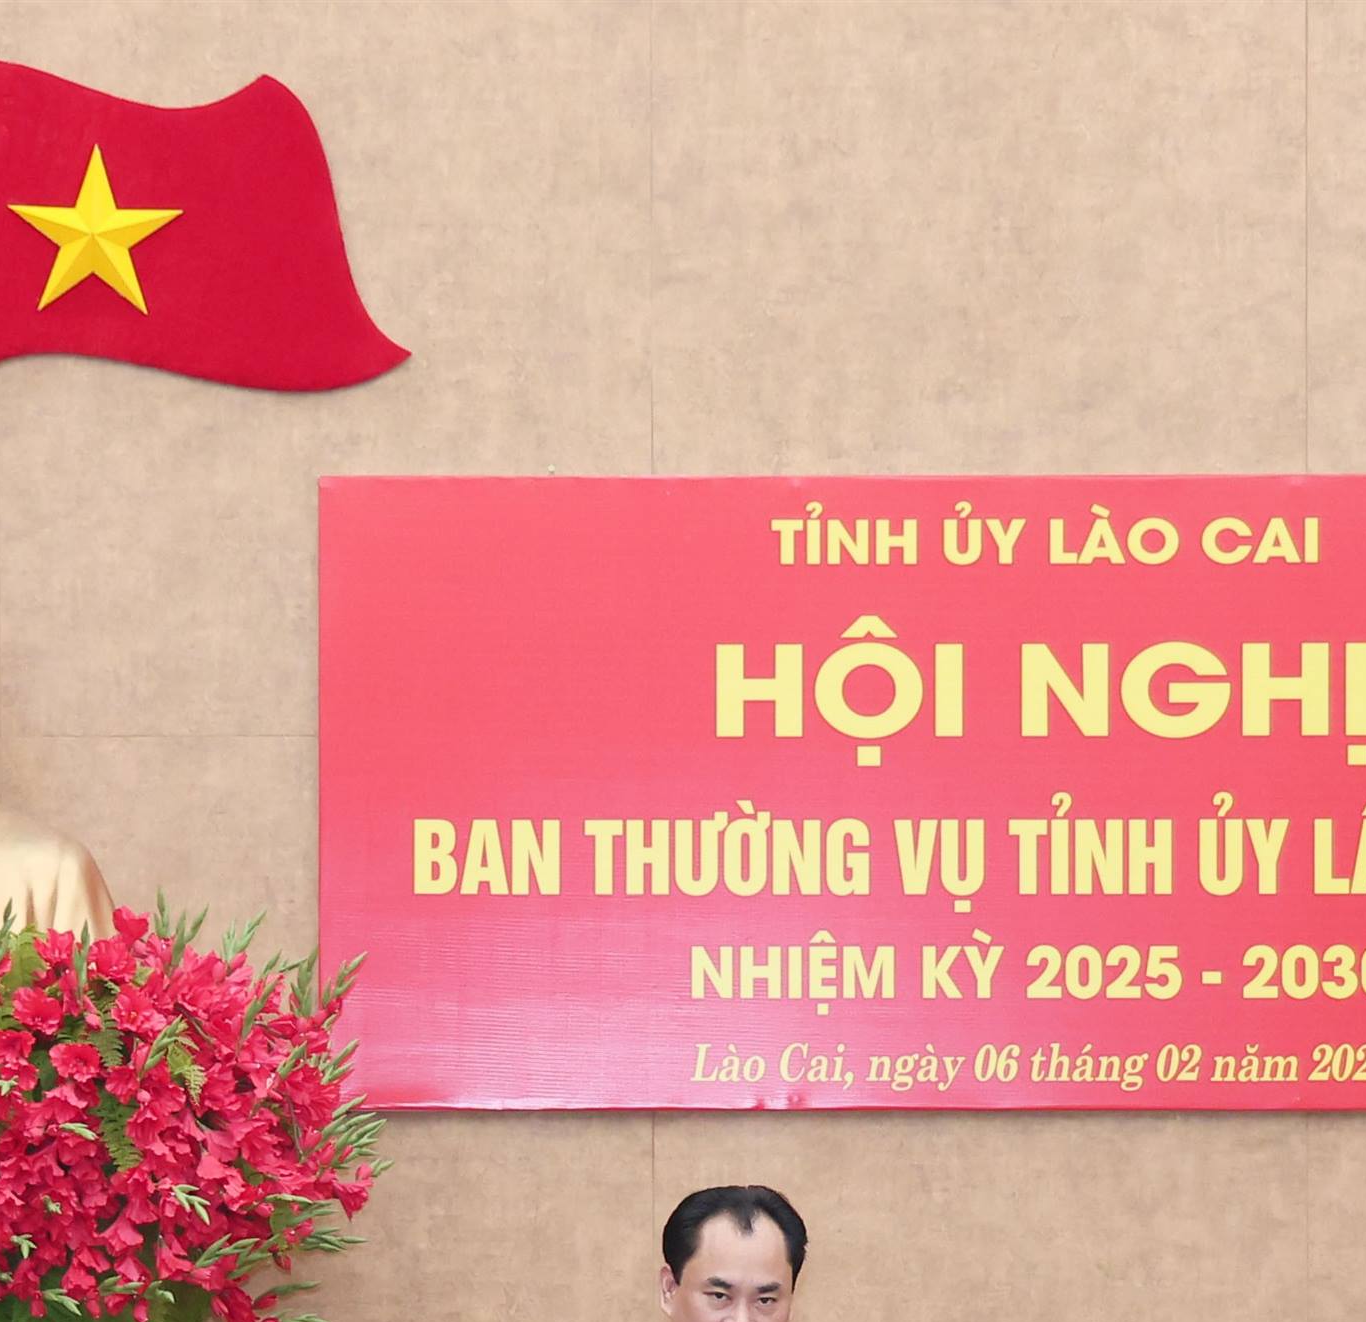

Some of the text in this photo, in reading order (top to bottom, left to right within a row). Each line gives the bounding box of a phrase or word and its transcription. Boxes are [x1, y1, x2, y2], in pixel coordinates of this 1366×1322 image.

[769, 499, 1320, 567] TỈNH ỦY LÀO CAI
[714, 614, 965, 768] HỘI
[412, 817, 562, 897] BAN
[583, 798, 872, 898] THƯỜNG
[892, 817, 986, 914] VỤ
[1007, 790, 1174, 896] TỈNH
[1198, 790, 1291, 897] ỦY
[690, 930, 897, 1016] NHIỆM
[921, 927, 1005, 1000] KỲ
[1025, 943, 1184, 1001] 2025
[1200, 969, 1223, 986] -
[692, 1044, 766, 1084] Lào
[779, 1043, 856, 1089] Cai,
[866, 1044, 966, 1092] ngày
[973, 1043, 1022, 1083] 06
[1030, 1042, 1150, 1092] tháng
[1155, 1042, 1203, 1083] 02
[1210, 1043, 1300, 1083] năm
